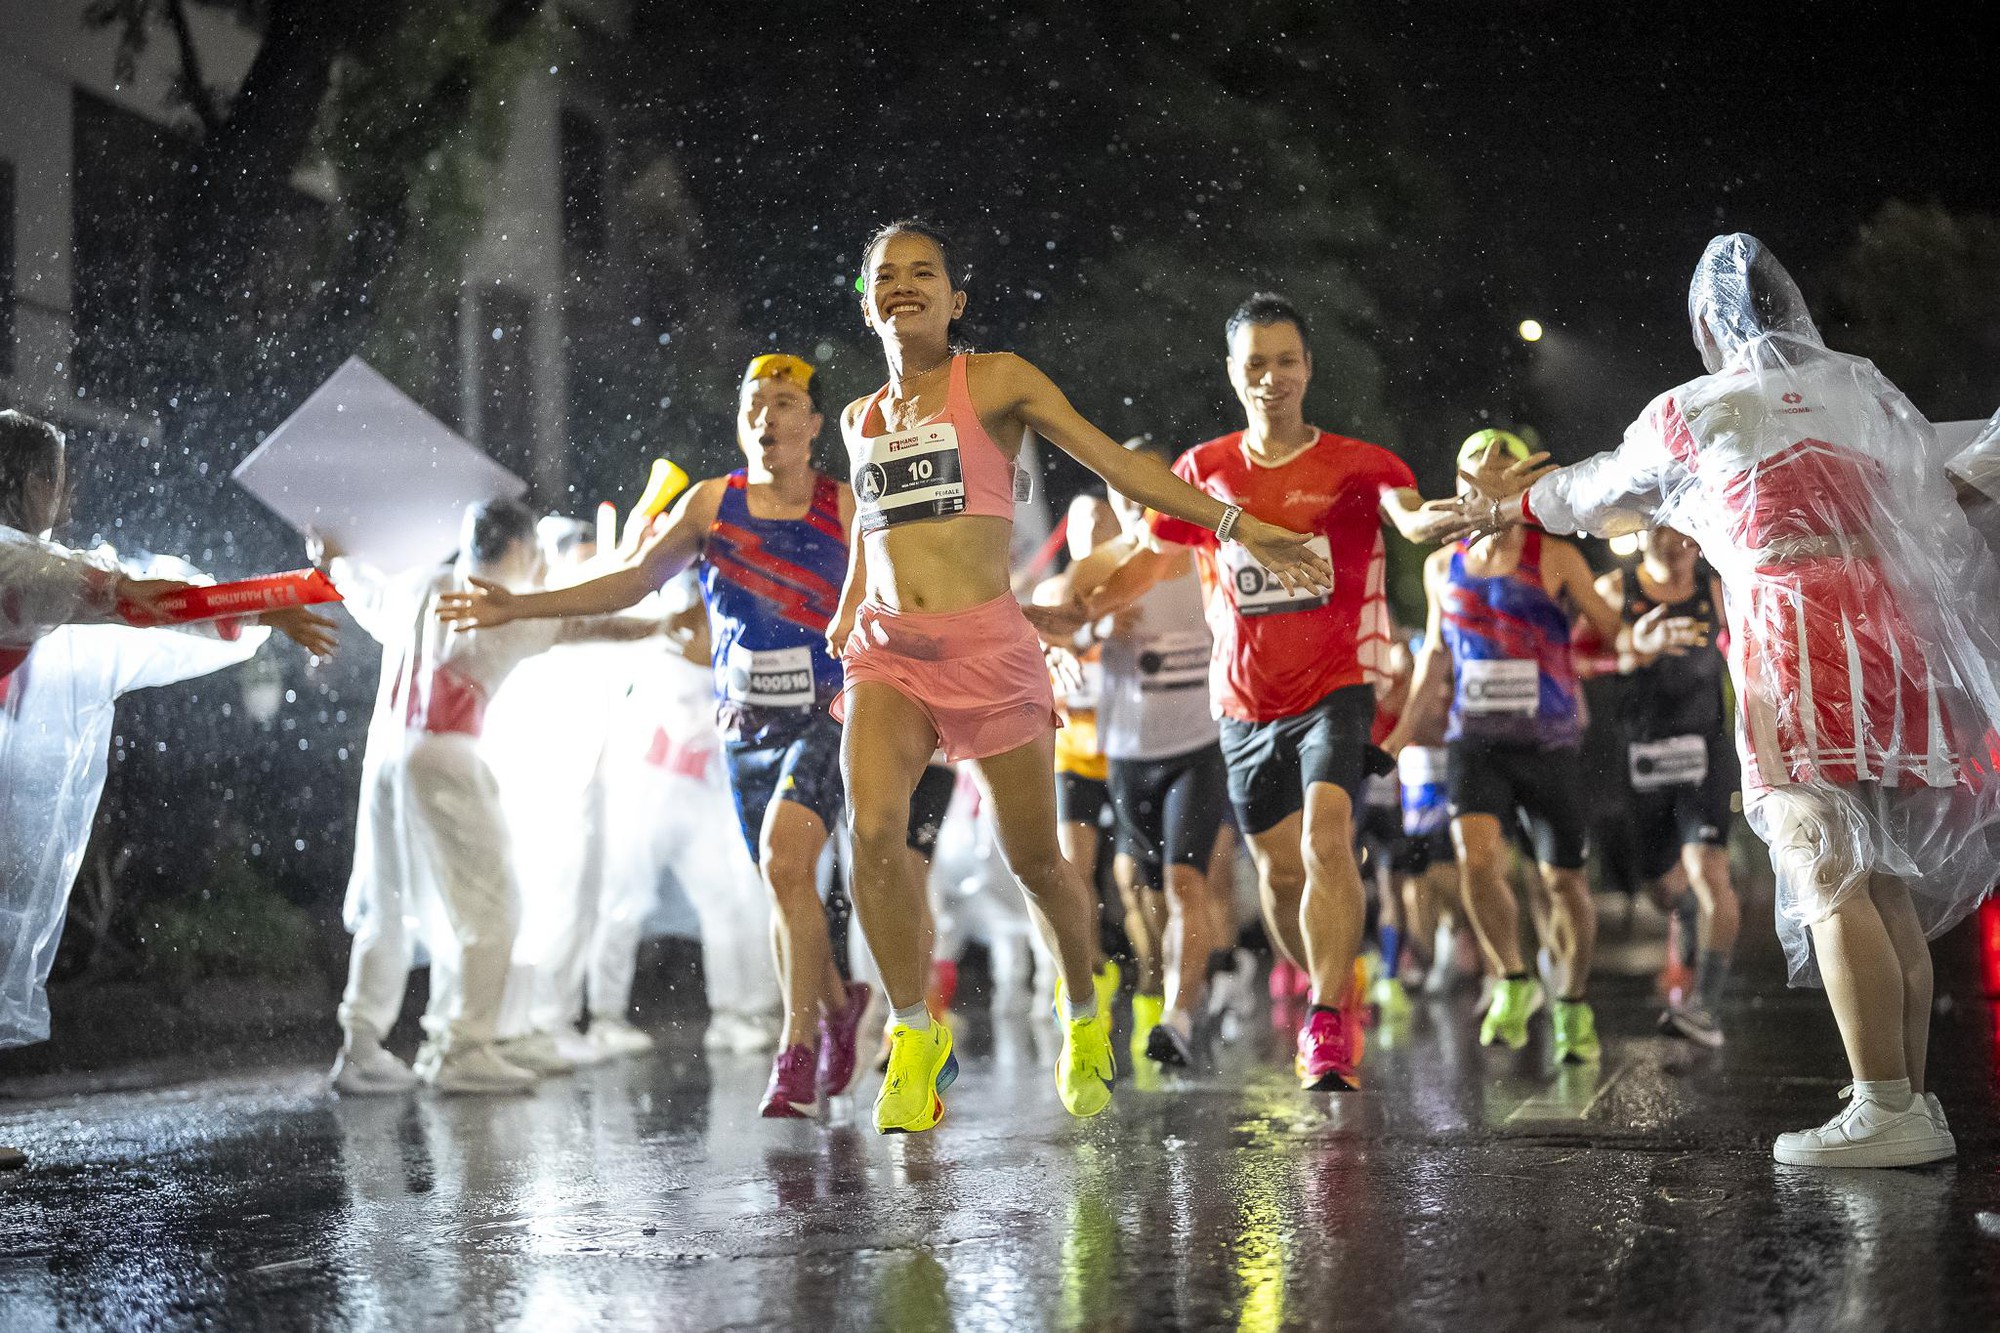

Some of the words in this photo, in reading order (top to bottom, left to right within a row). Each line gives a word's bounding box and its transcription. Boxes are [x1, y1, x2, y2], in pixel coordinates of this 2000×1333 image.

[900, 436, 919, 446] HANOI
[908, 459, 933, 481] 10
[862, 470, 880, 494] A
[934, 488, 960, 498] FEMALE
[1240, 572, 1257, 592] B
[207, 589, 261, 607] MARATHON
